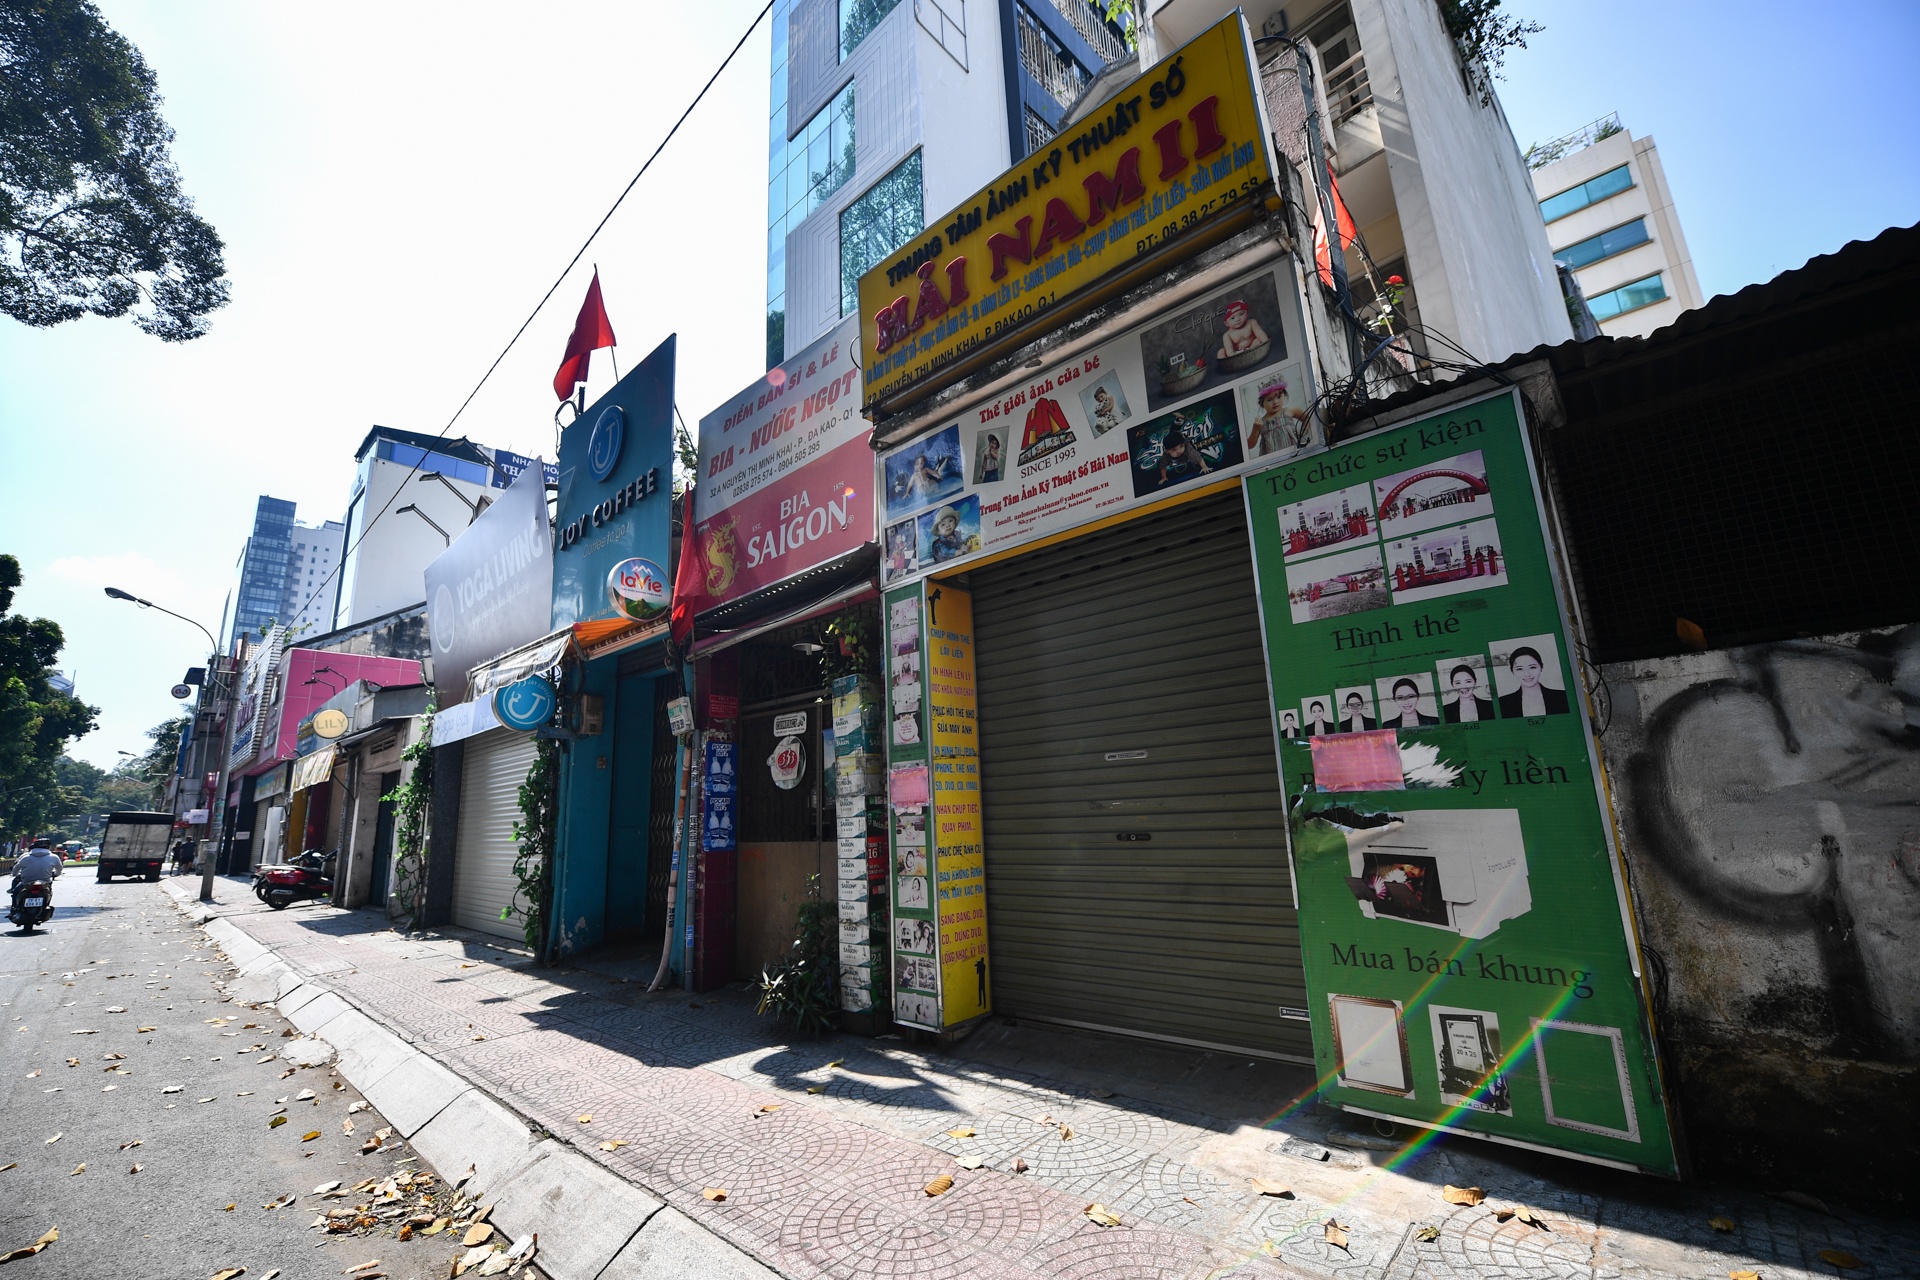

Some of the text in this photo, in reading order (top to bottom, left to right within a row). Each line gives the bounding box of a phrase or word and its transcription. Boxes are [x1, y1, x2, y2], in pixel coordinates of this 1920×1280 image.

[886, 235, 942, 287] TRUNG
[945, 207, 982, 246] TÂM
[986, 174, 1029, 221] ẢNH
[1067, 95, 1143, 164] THUẬT
[1149, 55, 1186, 110] SỐ
[1232, 140, 1256, 171] ẢNH
[873, 94, 1227, 354] HẢI NAM II
[1136, 232, 1159, 255] ĐT:
[1162, 222, 1178, 238] 08
[1181, 209, 1198, 228] 38
[931, 347, 954, 371] MINH
[724, 402, 753, 433] ĐIỂM
[757, 381, 785, 412] BÁN
[805, 361, 817, 378] &
[821, 341, 840, 368] LẺ
[980, 353, 1100, 424] Thế giới ảnh của bé
[708, 368, 858, 479] BIA NƯỚC NGỌT
[759, 455, 776, 470] MINH
[775, 445, 793, 460] KHAI
[819, 420, 837, 436] KAO
[842, 407, 854, 422] Q1
[778, 457, 794, 473] 0904
[794, 449, 807, 463] 505
[807, 440, 821, 457] 295
[1020, 446, 1077, 480] SINCE 1993
[1266, 418, 1487, 497] Tổ chức sự kiện
[980, 500, 1002, 517] Trung
[1002, 489, 1020, 509] Tâm
[1021, 483, 1037, 502] Ảnh
[1051, 470, 1077, 489] Thuật
[1077, 460, 1090, 480] Số
[1090, 456, 1106, 475] Hải
[1107, 450, 1130, 468] Nam
[559, 467, 658, 551] JOY COFFEE
[780, 489, 811, 520] BIA
[583, 538, 607, 558] Coffee
[747, 493, 848, 569] SAIGON
[456, 565, 495, 614] YOGA
[494, 528, 544, 588] LIVING
[1331, 610, 1461, 652] Hình thẻ
[932, 666, 939, 676] IN
[315, 718, 346, 731] LILY
[776, 718, 798, 731] COMPACT
[1462, 718, 1547, 732] 4x6 5x7
[711, 743, 733, 751] POCARI
[1503, 754, 1571, 787] liền
[709, 797, 731, 805] POCARI
[942, 822, 957, 834] QUAY
[868, 848, 878, 859] 16
[1330, 943, 1595, 999] Mua bán khung
